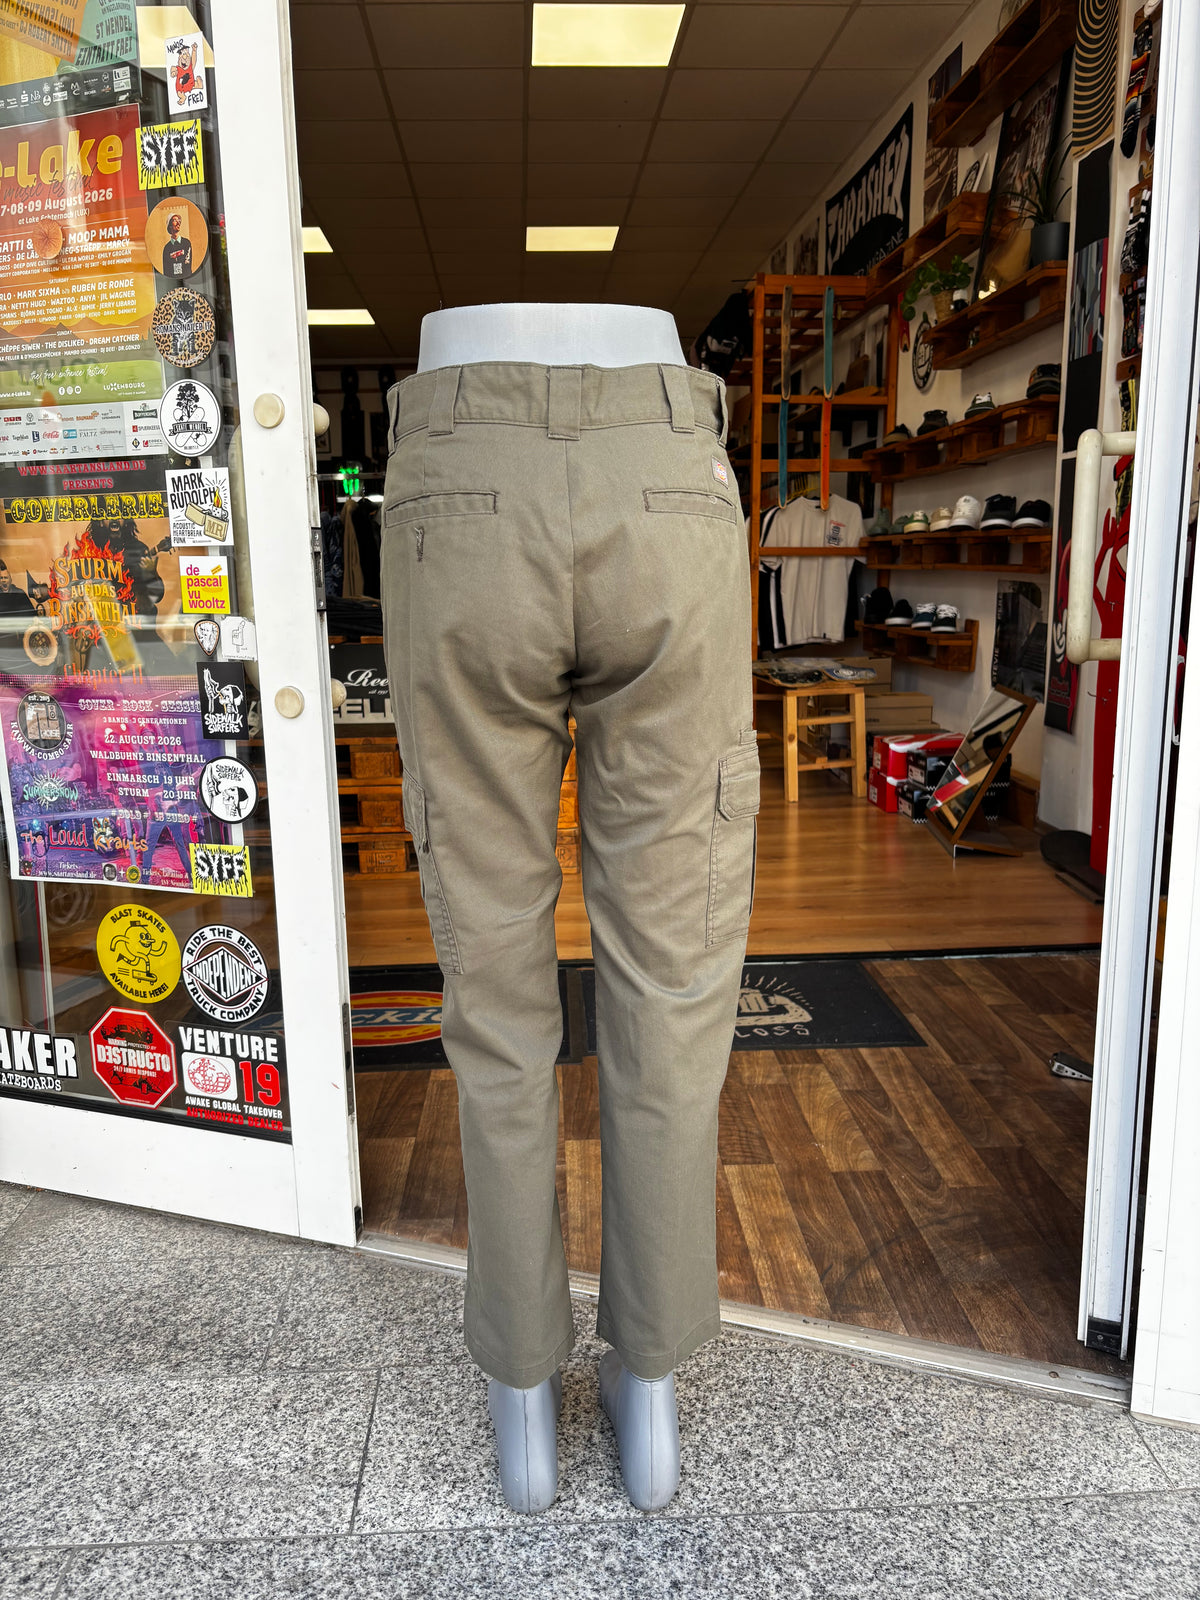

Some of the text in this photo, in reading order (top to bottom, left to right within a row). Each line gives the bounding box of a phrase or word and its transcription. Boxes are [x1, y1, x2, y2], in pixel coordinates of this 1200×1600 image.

[96, 15, 132, 39] ST WENDEL
[51, 33, 72, 56] SMITH
[75, 36, 133, 66] EINTRITT FREI
[188, 91, 204, 106] FRED
[0, 130, 123, 189] -Lake
[44, 187, 114, 213] August 2026
[827, 123, 910, 275] THRASHER
[69, 230, 97, 245] MOOP
[99, 225, 130, 241] MAMA
[16, 239, 131, 261] DE MARCY
[17, 290, 37, 299] MARK
[38, 287, 61, 297] SIXMA
[71, 283, 97, 294] RUBEN
[97, 281, 108, 290] DE
[108, 278, 134, 289] RONDE
[11, 301, 30, 310] NETTY
[30, 299, 47, 308] HUGO
[80, 294, 96, 303] ANYA
[109, 290, 136, 300] WAGNER
[99, 301, 115, 310] JERRY
[155, 324, 181, 335] ROMANS
[44, 341, 57, 349] THE
[57, 338, 85, 348] DISLIKED
[89, 336, 111, 345] DREAM
[111, 333, 140, 343] CATCHER
[103, 382, 146, 391] LUXEMBOURG
[17, 459, 147, 477] WWW.SAARTANSLAND.DE
[62, 478, 114, 491] PRESENTS
[170, 472, 206, 493] MARK
[10, 491, 165, 524] COVERLERIE
[169, 486, 216, 511] RUDOLPH
[172, 522, 196, 530] ACOUSTIC
[172, 529, 203, 537] HEARTBREAK
[206, 519, 224, 539] MR
[173, 536, 187, 544] PUNK
[54, 557, 125, 589] STURM
[186, 564, 200, 576] de
[71, 584, 117, 599] AUF DAS
[186, 575, 222, 590] pascal
[187, 589, 201, 600] vu
[188, 598, 226, 610] wooltz
[48, 597, 142, 632] BINSENTHAL
[78, 698, 116, 712] COVER
[122, 699, 154, 712] ROCK
[137, 717, 188, 725] GENERATIONEN
[204, 713, 243, 728] SIDEWALK
[207, 722, 241, 734] SURFERS
[104, 734, 182, 746] 22. AUGUST 2026
[146, 752, 207, 763] BINSENTHAL
[106, 772, 196, 786] EINMARSCH 19 UHR
[215, 764, 245, 779] SIDEWALK
[217, 772, 242, 782] SURFERS
[118, 787, 198, 800] STURM 20 UHR
[20, 823, 149, 852] The Loud Krauts
[110, 908, 167, 934] BLAST SKATES
[187, 927, 263, 966] RIDE THE BEST
[192, 949, 257, 999] INDEPENDENT
[109, 972, 170, 999] AVAILABLE HERE!
[187, 979, 265, 1021] TRUCK COMPANY
[128, 1042, 151, 1050] PROTECTED
[178, 1026, 279, 1063] VENTURE
[96, 1044, 171, 1073] DESTRUCTO
[123, 1067, 137, 1075] ARMED
[137, 1069, 157, 1078] RESPONSE
[238, 1060, 281, 1107] 19
[185, 1095, 283, 1119] AWAKE GLOBAL TAKEOVER
[186, 1106, 284, 1132] AUTHORIZED DEALER
